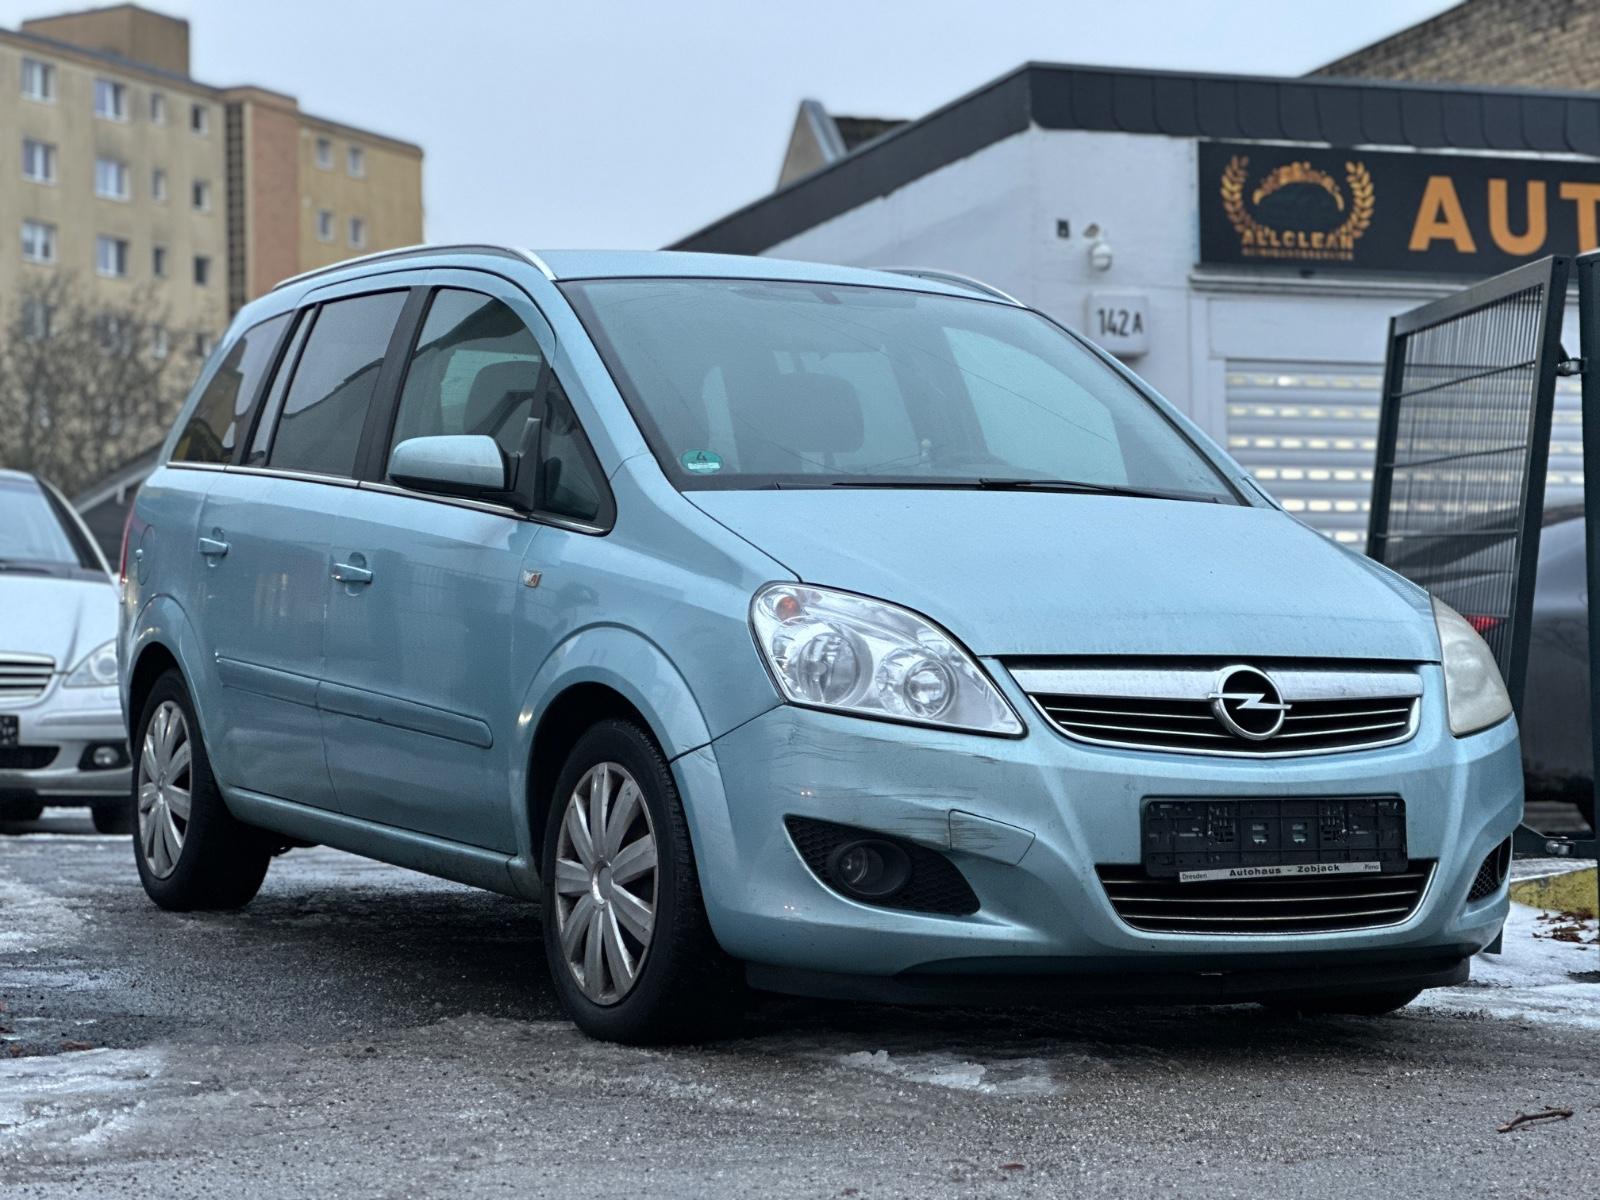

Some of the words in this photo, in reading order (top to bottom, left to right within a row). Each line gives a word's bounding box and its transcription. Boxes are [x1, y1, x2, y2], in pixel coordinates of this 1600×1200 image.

[1241, 228, 1354, 249] ALLCLEAN
[1098, 308, 1144, 337] 142A
[1181, 872, 1208, 881] Dresden
[1229, 866, 1282, 877] Autohaus
[1297, 864, 1341, 873] Zobjack
